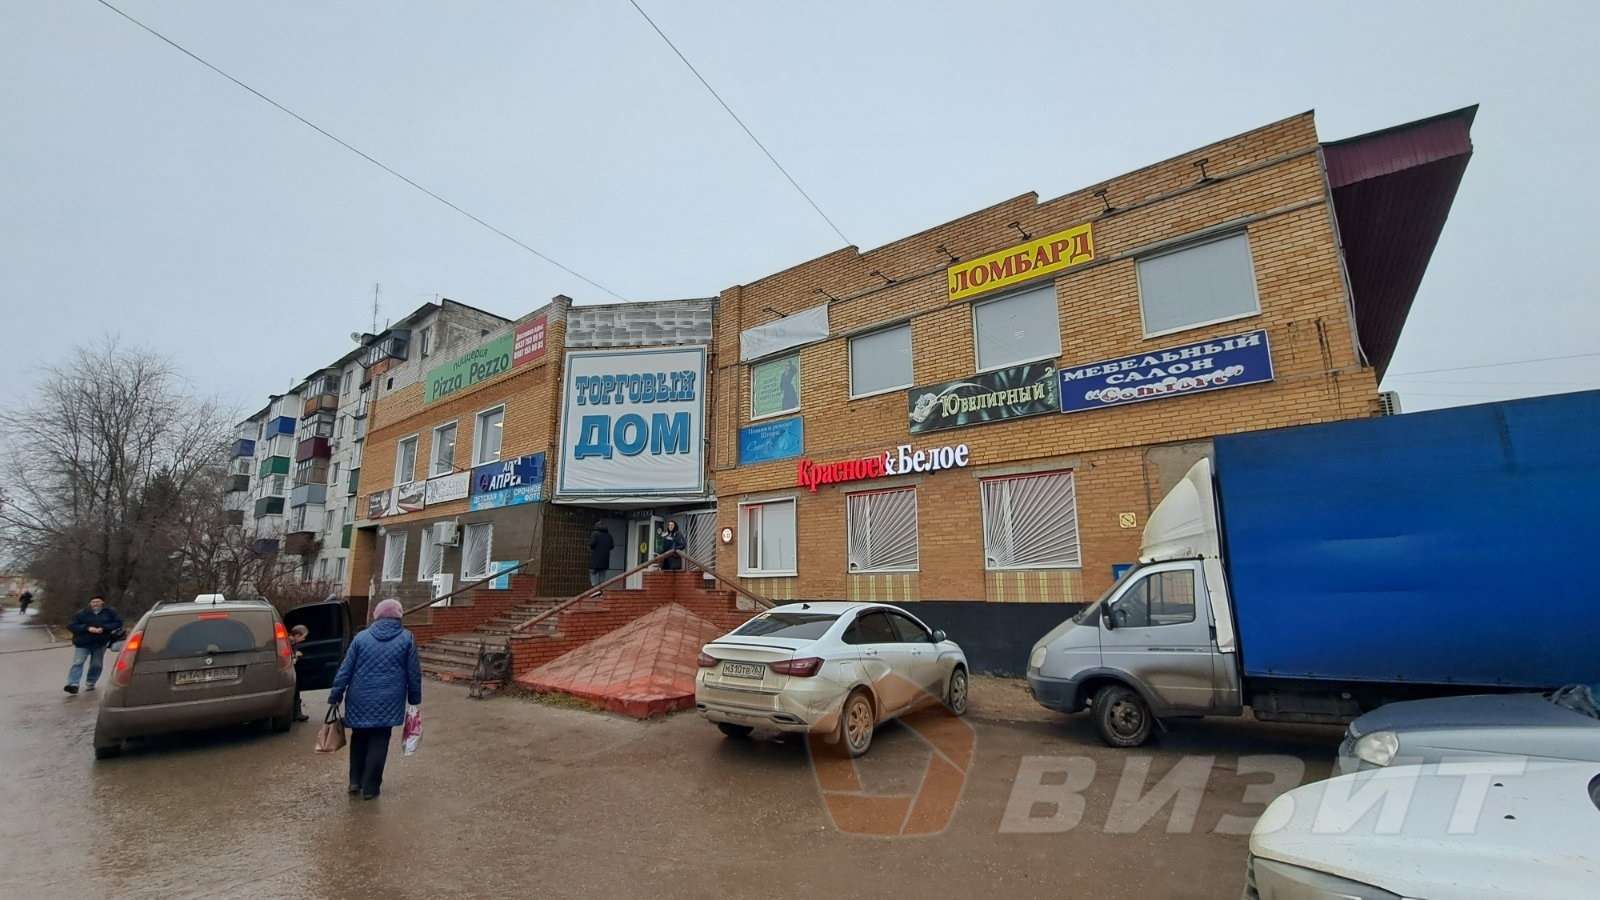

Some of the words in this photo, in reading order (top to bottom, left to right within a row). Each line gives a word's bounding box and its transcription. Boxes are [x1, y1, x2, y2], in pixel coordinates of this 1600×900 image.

[951, 232, 1092, 293] ЛОМБАРД
[432, 374, 463, 399] Pizza
[469, 353, 509, 384] Pezzo
[1064, 334, 1260, 381] МЕБЕЛЬНЫЙ
[1106, 357, 1214, 384] САЛОН
[575, 370, 696, 405] ТОРГОВЫЙ
[574, 411, 691, 460] ДОМ
